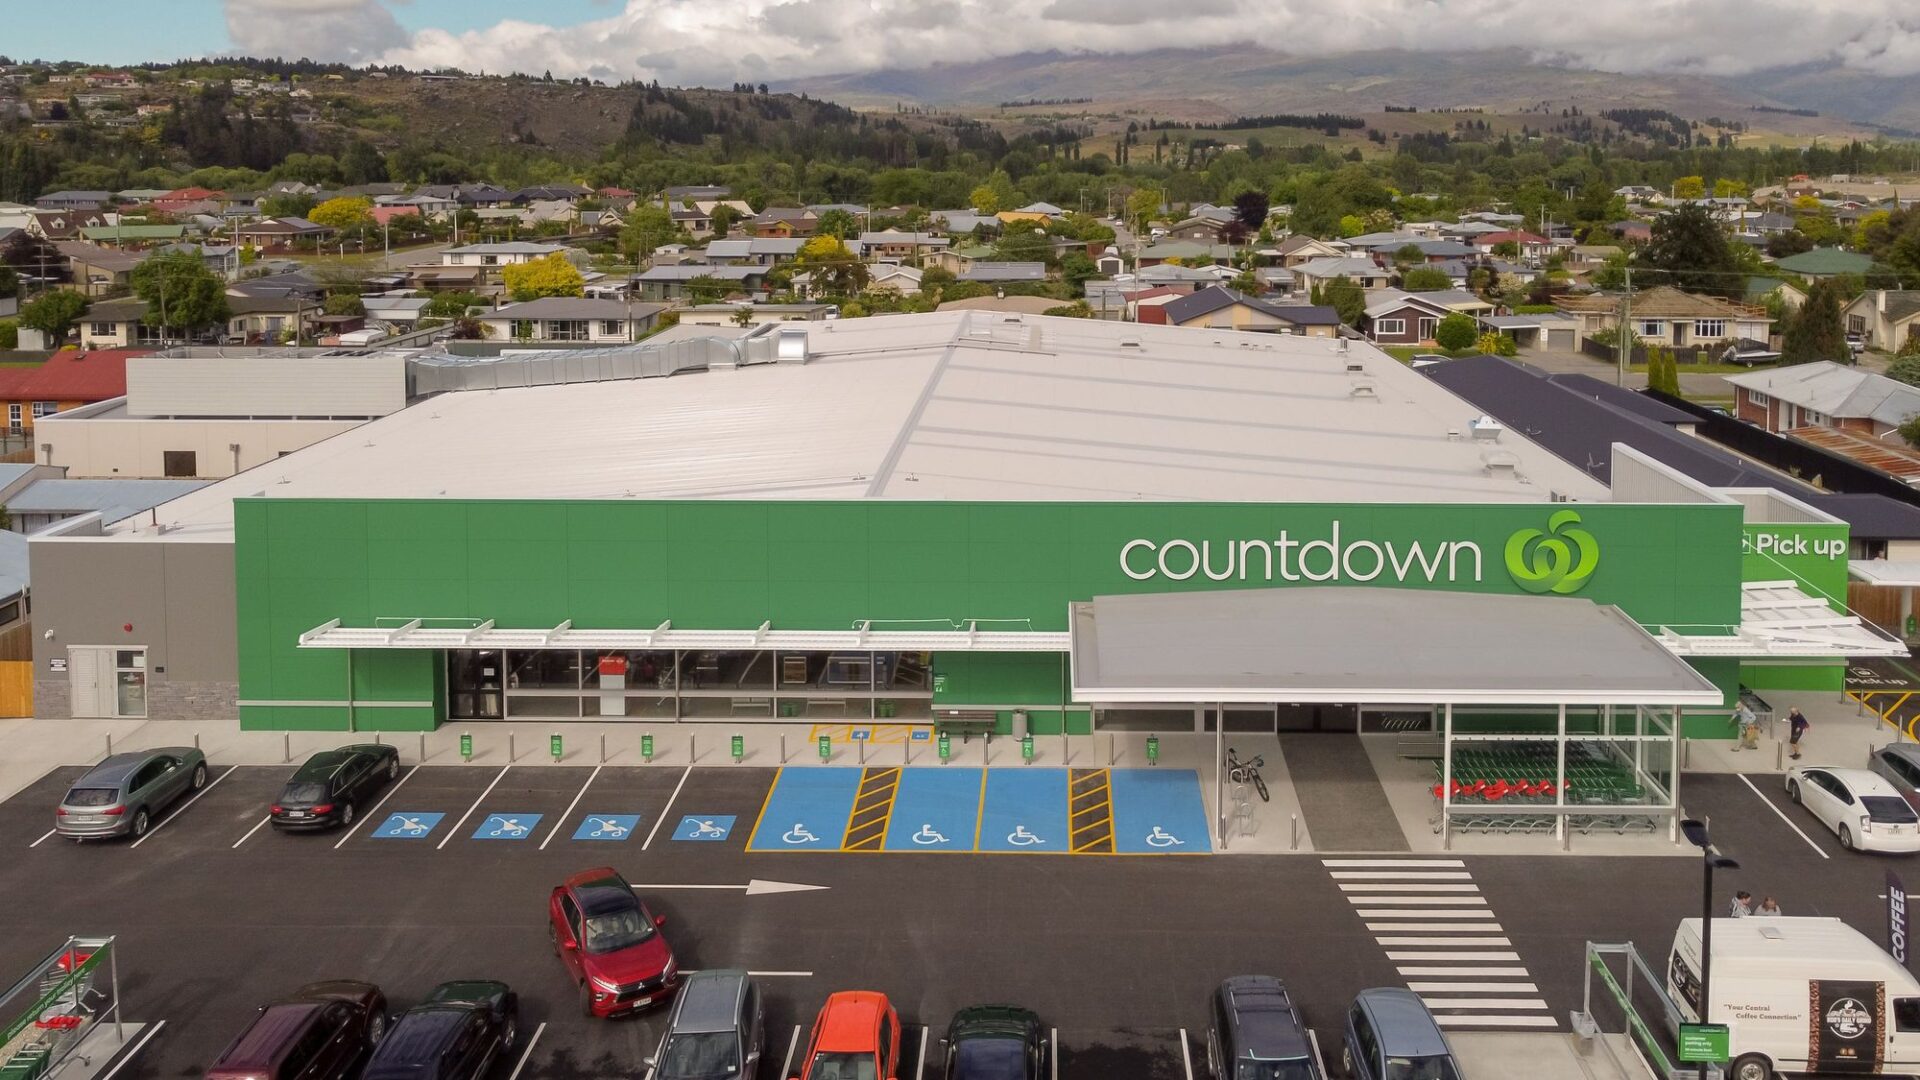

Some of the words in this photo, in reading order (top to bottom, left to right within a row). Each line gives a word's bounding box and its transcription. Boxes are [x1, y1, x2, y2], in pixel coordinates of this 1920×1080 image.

[1119, 520, 1482, 582] countdown
[1757, 533, 1808, 554] Pick
[1813, 539, 1846, 560] up
[1890, 886, 1905, 963] COFFEE
